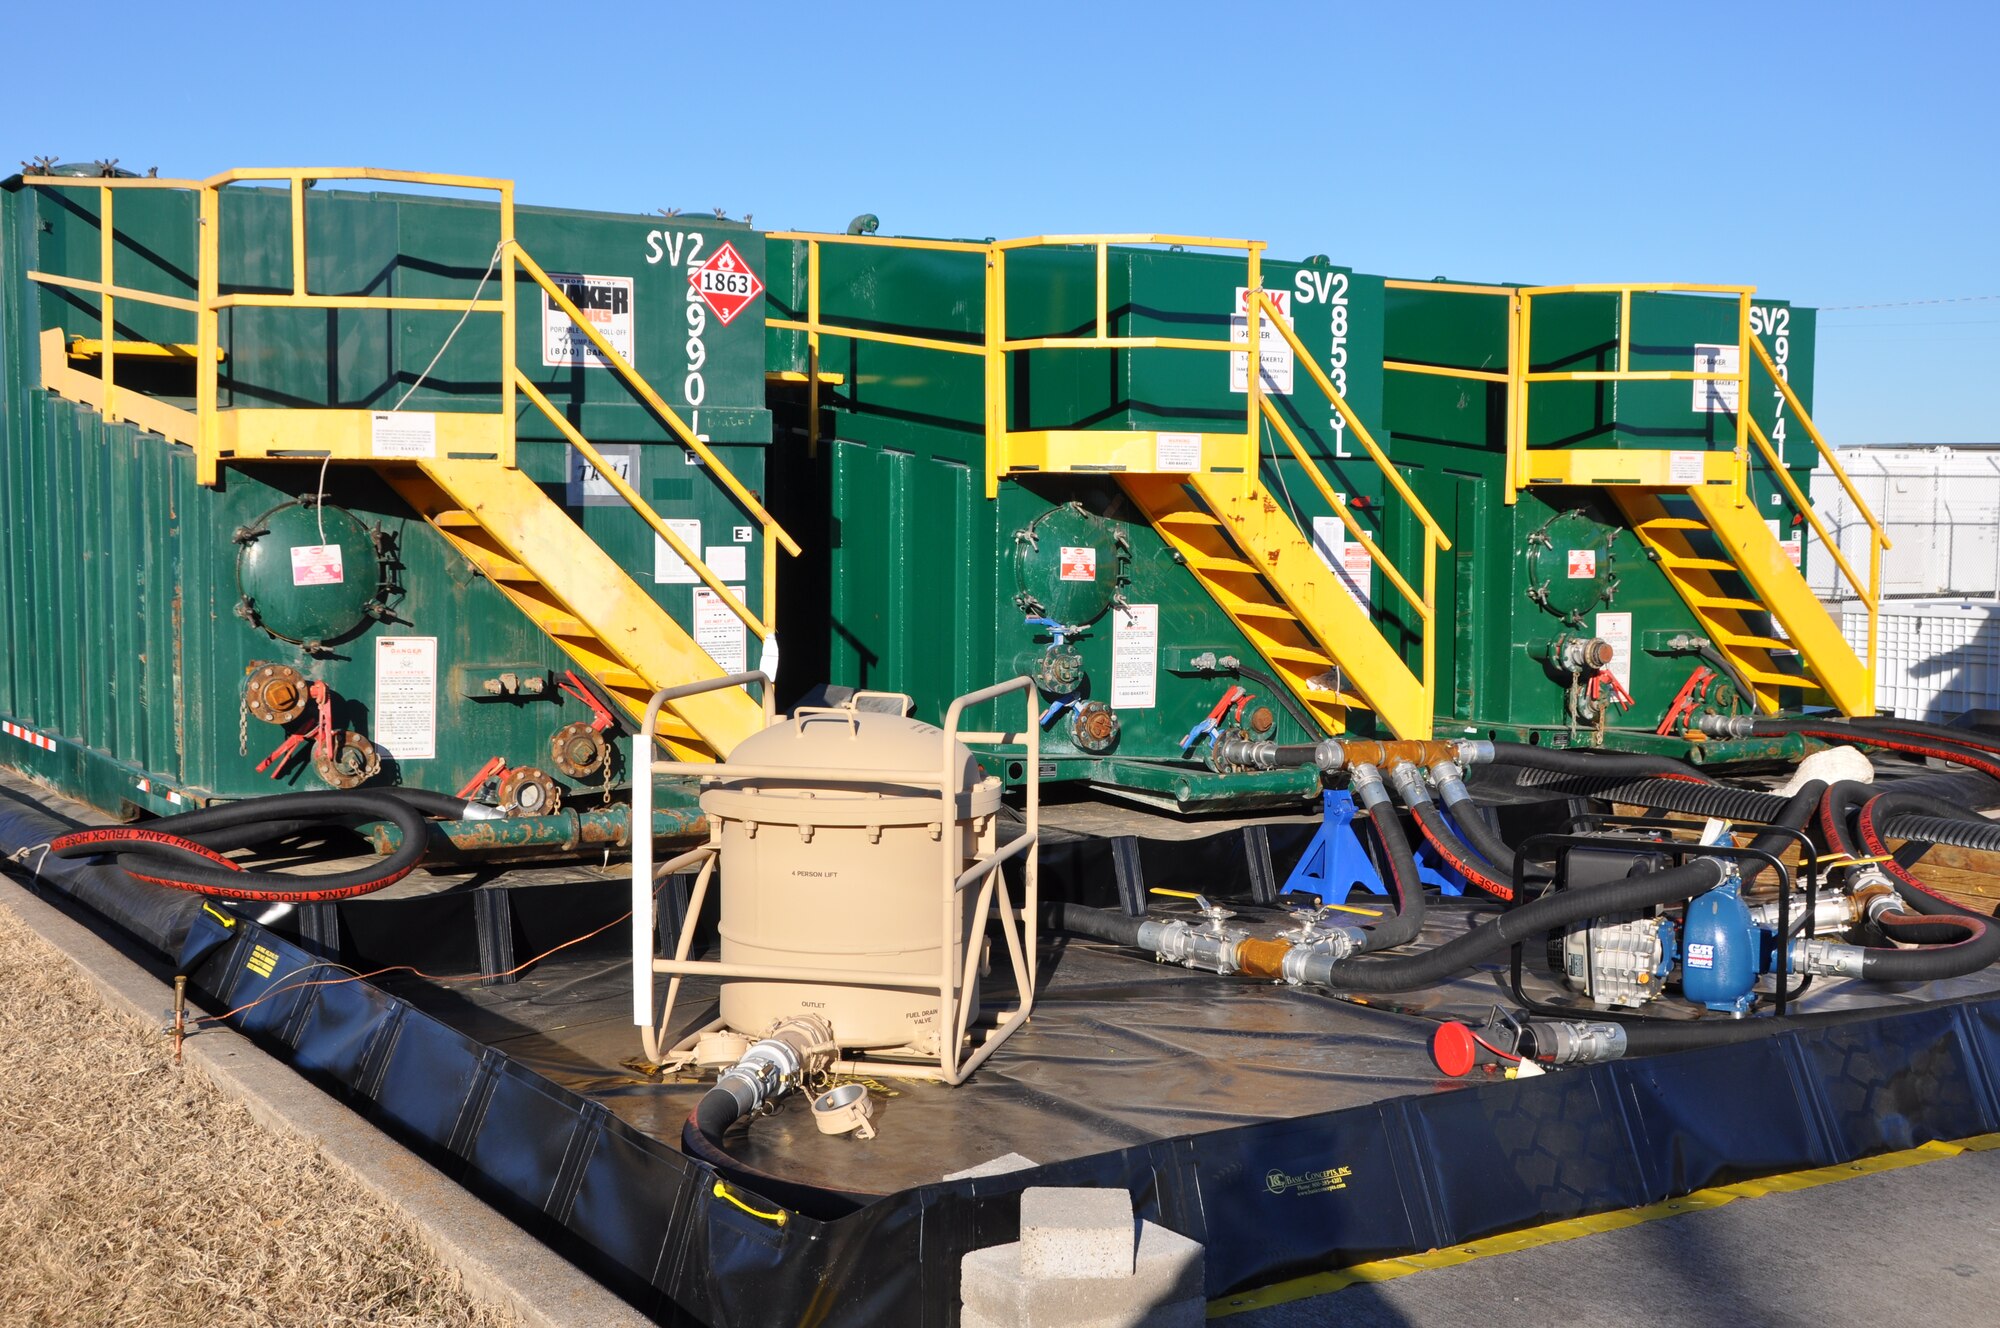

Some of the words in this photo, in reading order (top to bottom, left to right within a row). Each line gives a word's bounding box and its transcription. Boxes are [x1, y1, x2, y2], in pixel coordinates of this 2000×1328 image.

[646, 230, 706, 266] SV2
[704, 272, 748, 294] 1863
[1294, 269, 1349, 305] SV2
[722, 308, 729, 318] 3
[1749, 306, 1790, 336] SV2
[550, 326, 579, 334] PORTABLE
[551, 347, 580, 357] (800)
[735, 529, 744, 540] E
[65, 832, 90, 847] HOSE
[100, 830, 132, 840] TRUCK
[136, 830, 170, 844] TANK
[175, 838, 209, 856] MWH
[1862, 821, 1873, 840] TANK
[1869, 841, 1890, 865] TRUK
[1889, 862, 1914, 882] HOSE
[1479, 876, 1508, 898] HOSE
[213, 888, 253, 899] HOSE
[259, 891, 310, 902] TRUCK
[318, 888, 354, 900] TANK
[801, 1001, 826, 1009] OUTLET
[905, 1011, 920, 1019] FUEL
[921, 1009, 938, 1017] DRAIN
[914, 1017, 932, 1025] VALVE
